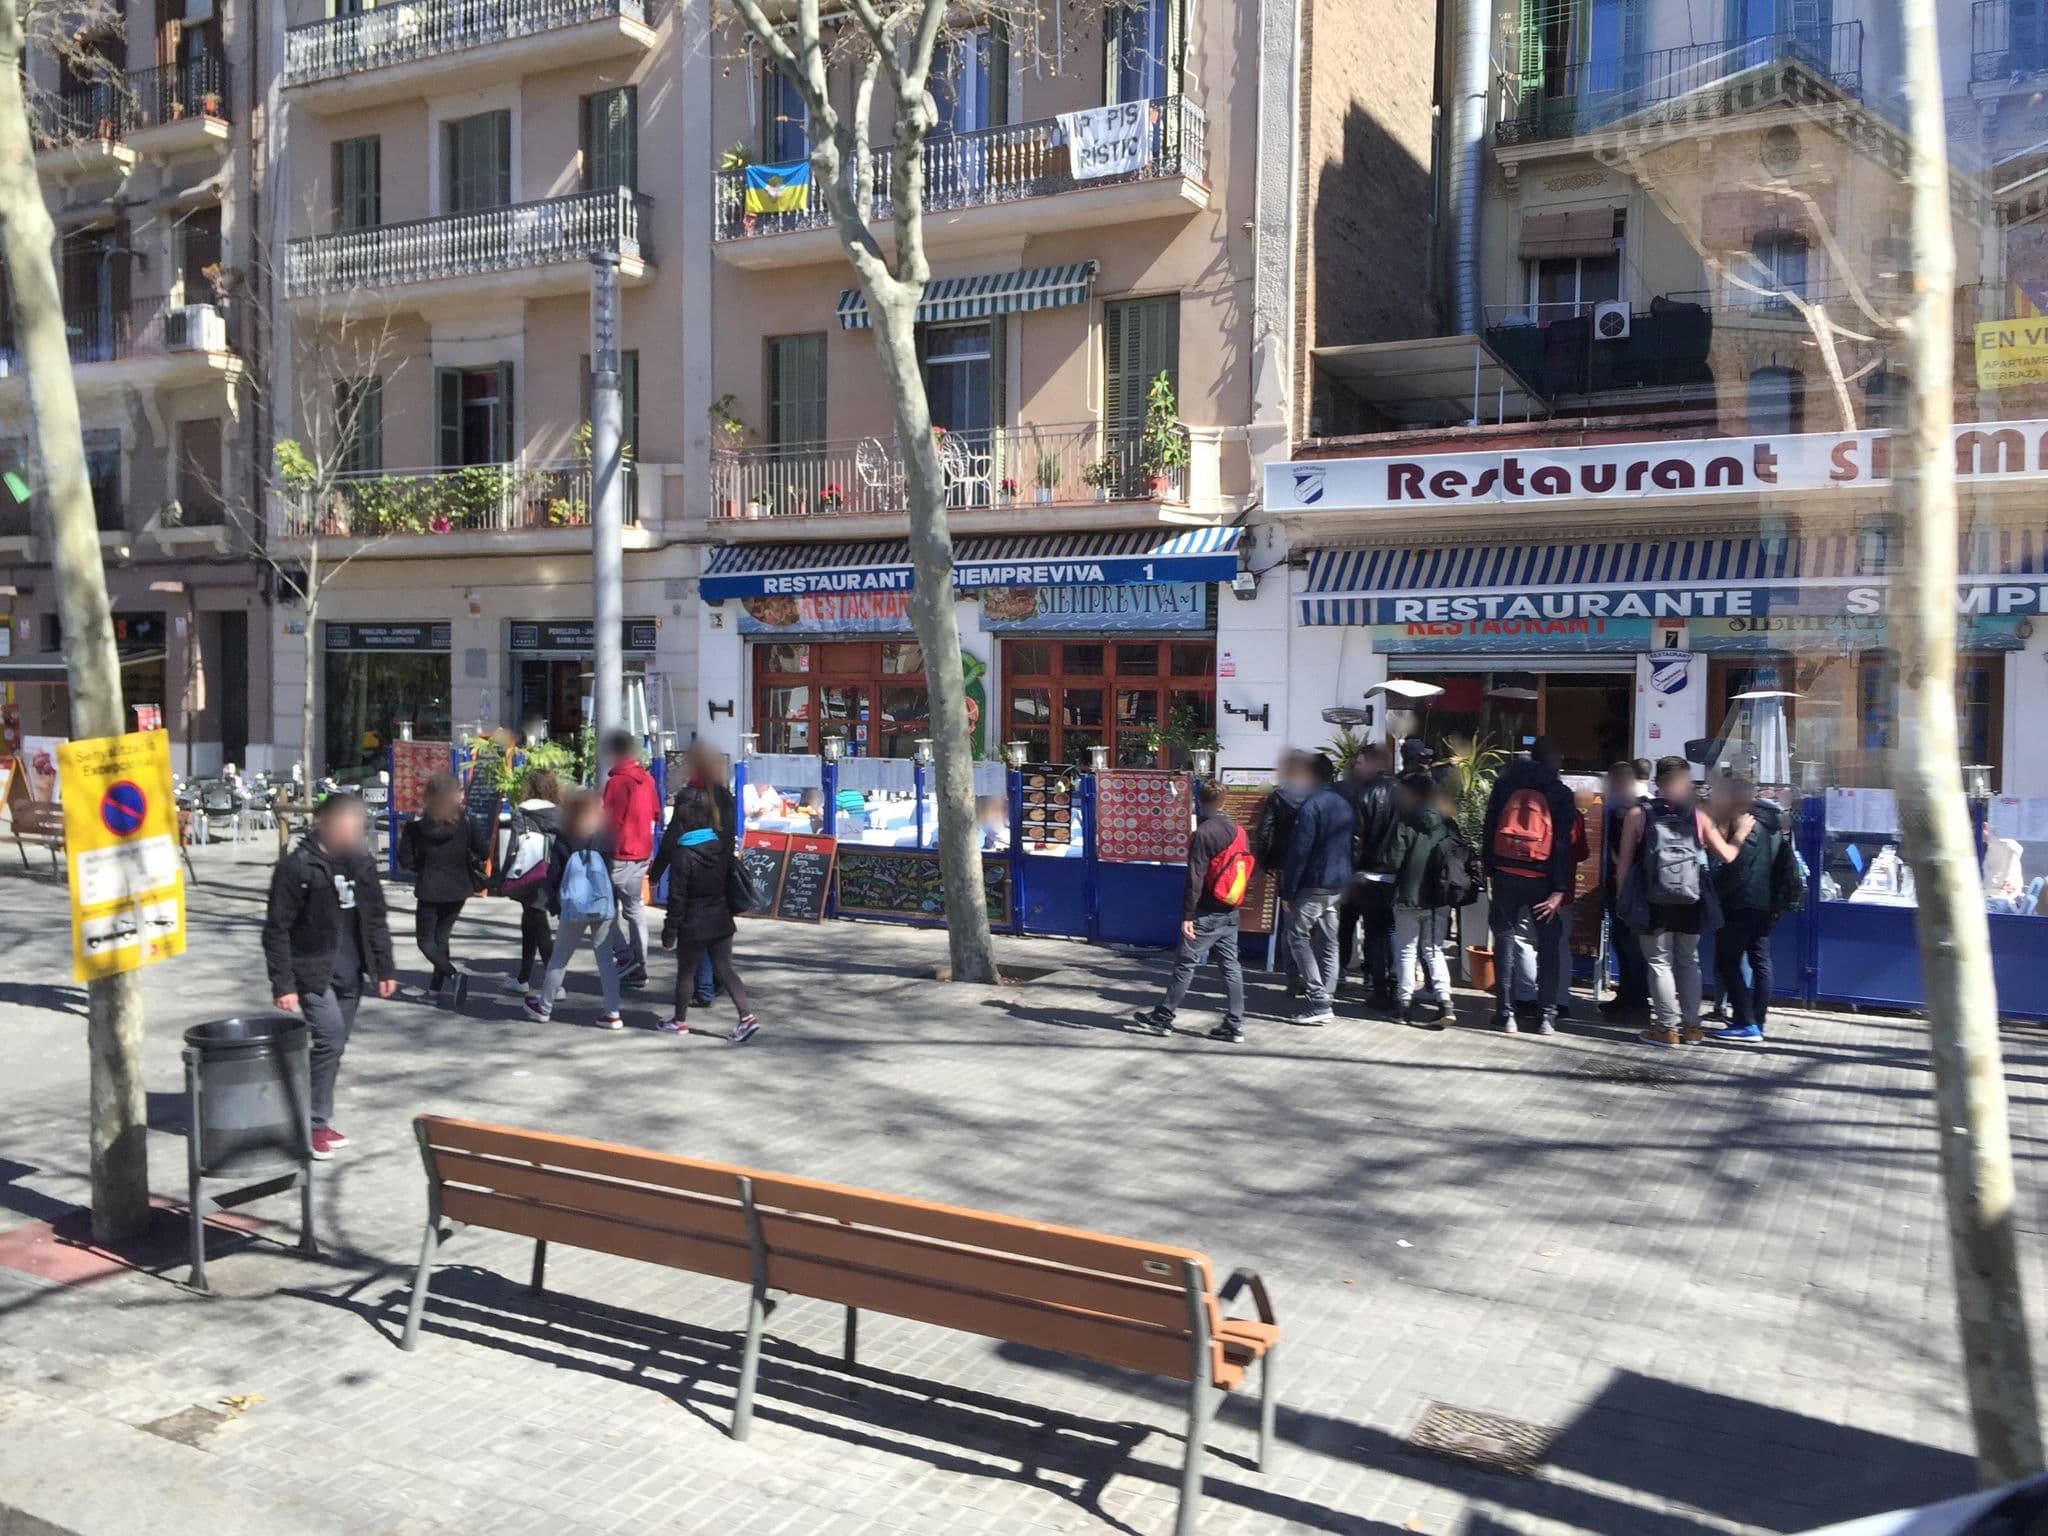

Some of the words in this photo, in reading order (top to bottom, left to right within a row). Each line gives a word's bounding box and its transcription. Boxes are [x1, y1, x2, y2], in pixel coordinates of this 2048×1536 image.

[1107, 103, 1138, 131] PIS
[1980, 330, 2016, 350] EN
[2025, 327, 2048, 345] V
[1983, 355, 2048, 369] APARTAME
[1983, 369, 2042, 381] TERRAZA
[1387, 443, 1778, 500] Restaurant
[764, 571, 910, 594] RESTAURANT
[1143, 563, 1154, 580] 1
[1395, 590, 1753, 623] RESTAURANTE
[1667, 632, 1677, 648] 7
